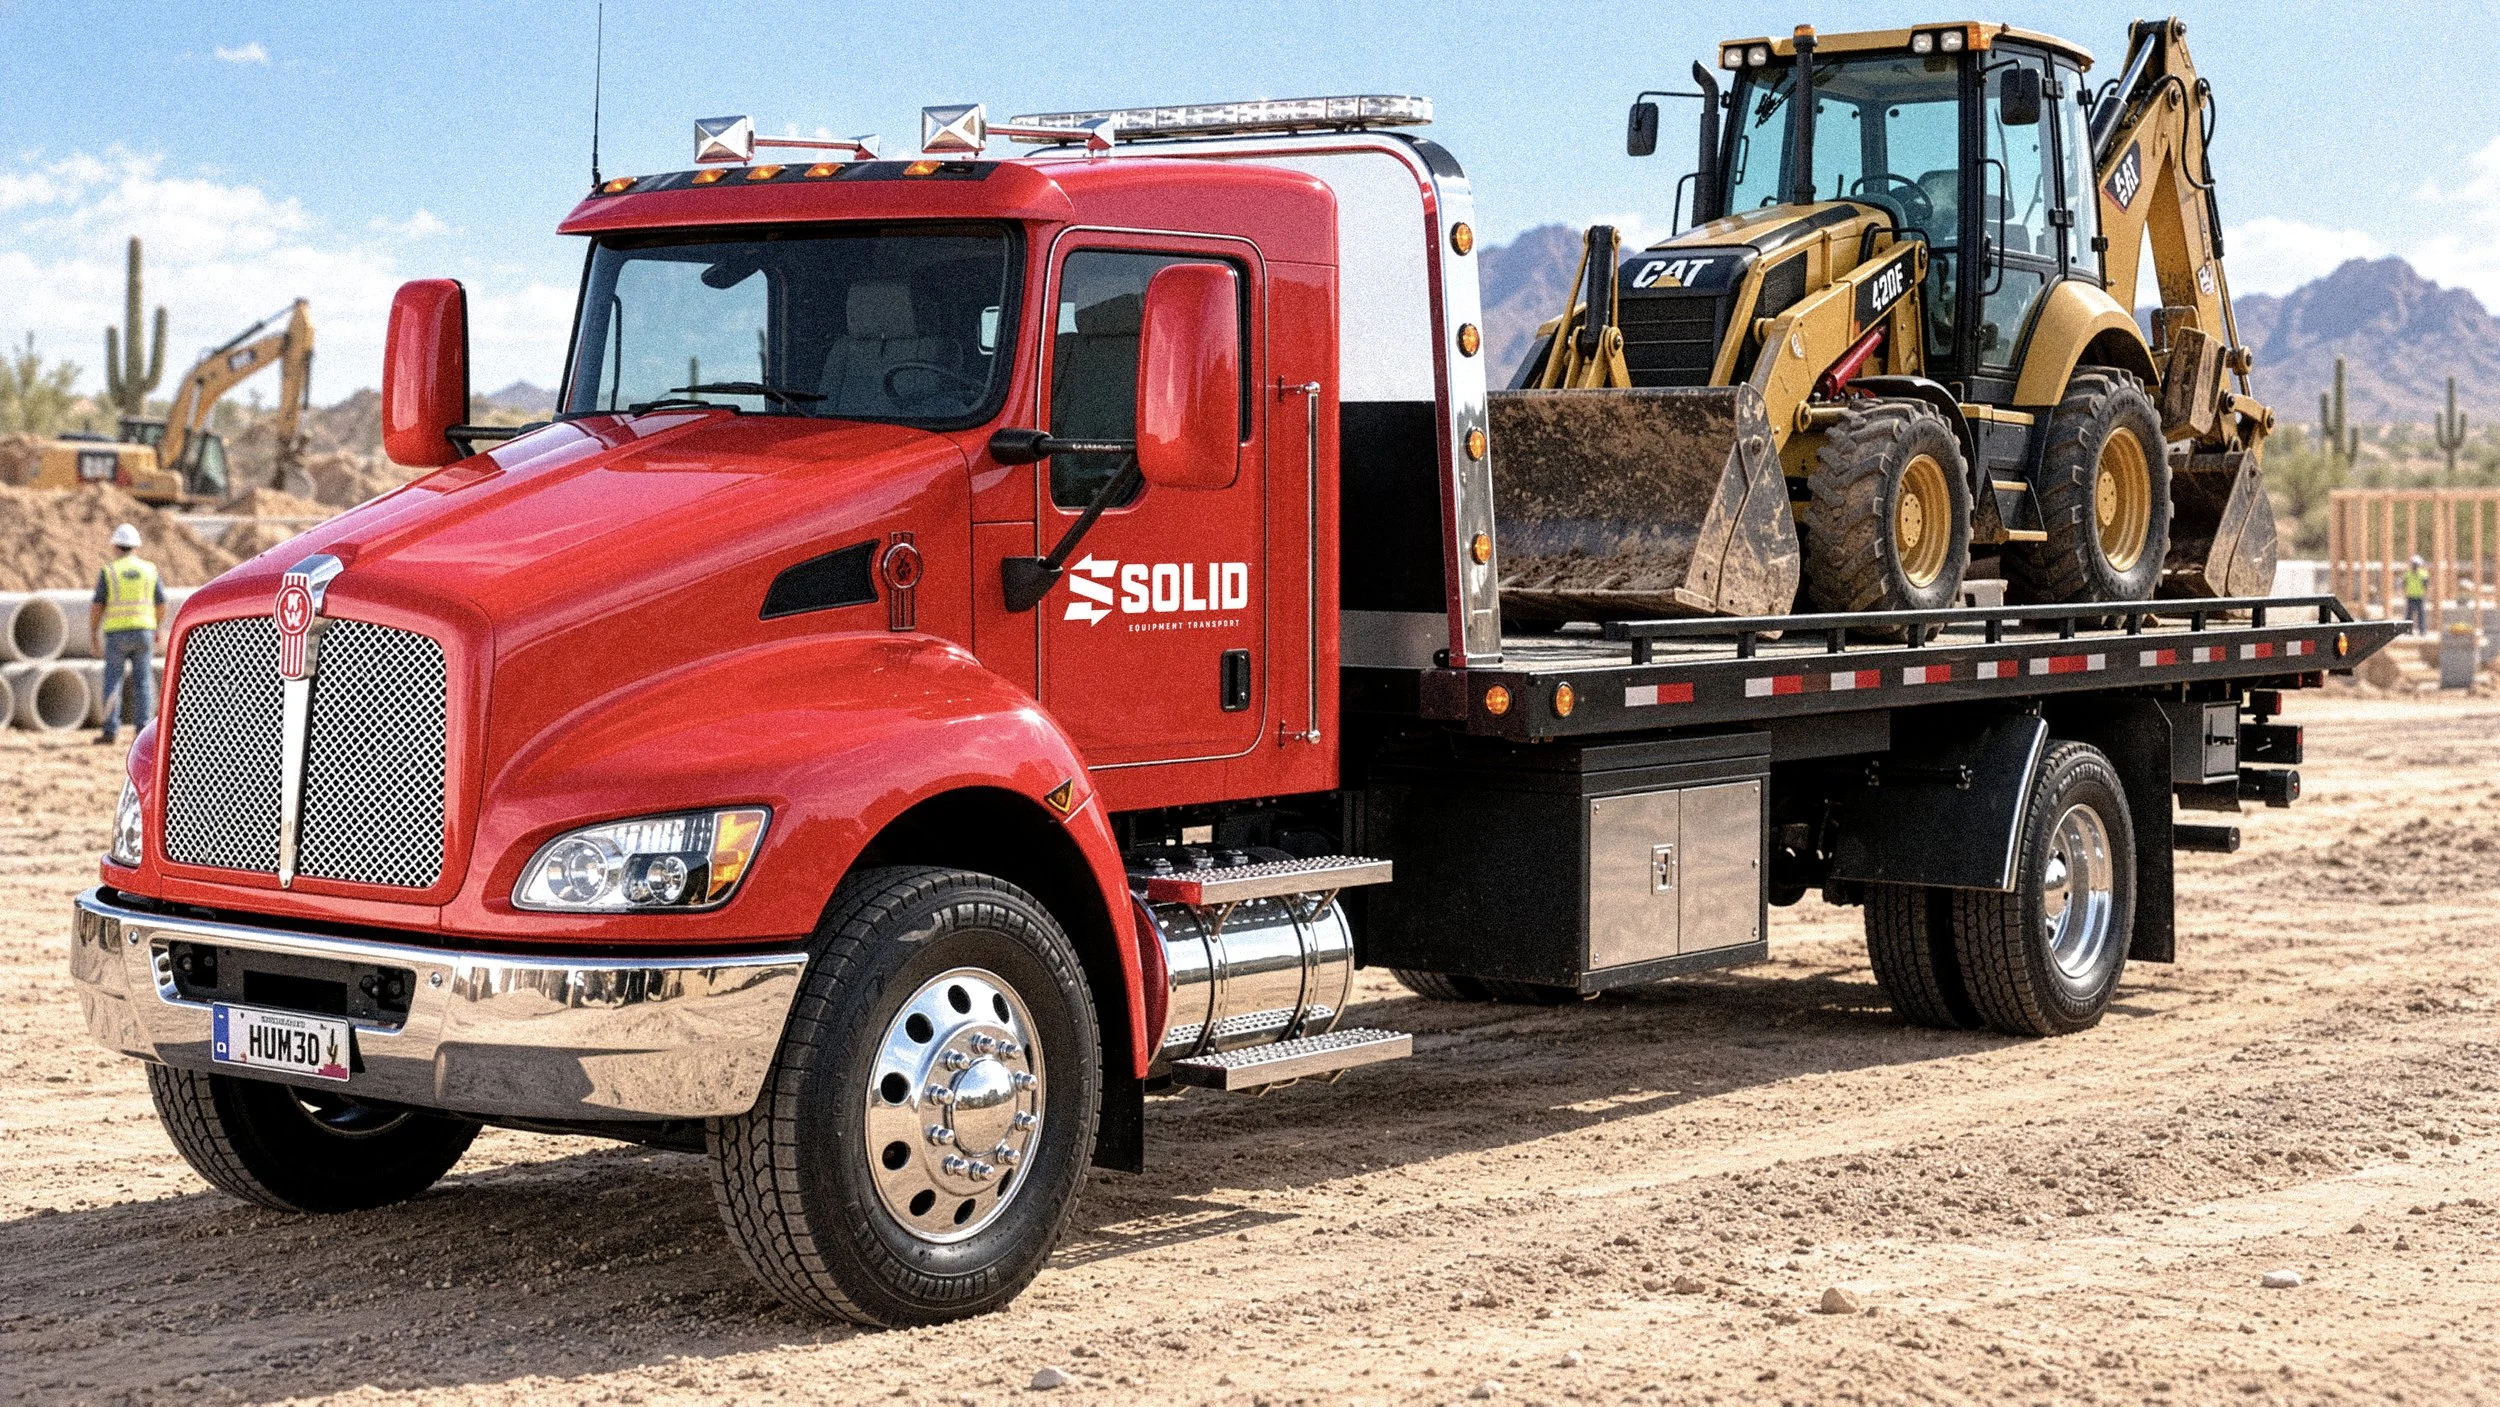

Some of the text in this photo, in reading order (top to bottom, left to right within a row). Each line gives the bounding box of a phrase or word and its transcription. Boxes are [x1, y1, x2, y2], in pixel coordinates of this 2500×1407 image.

[1632, 259, 1715, 289] CAT
[1121, 562, 1248, 614] SOLID
[1128, 619, 1240, 633] EQUIPMENT TRANSPORT
